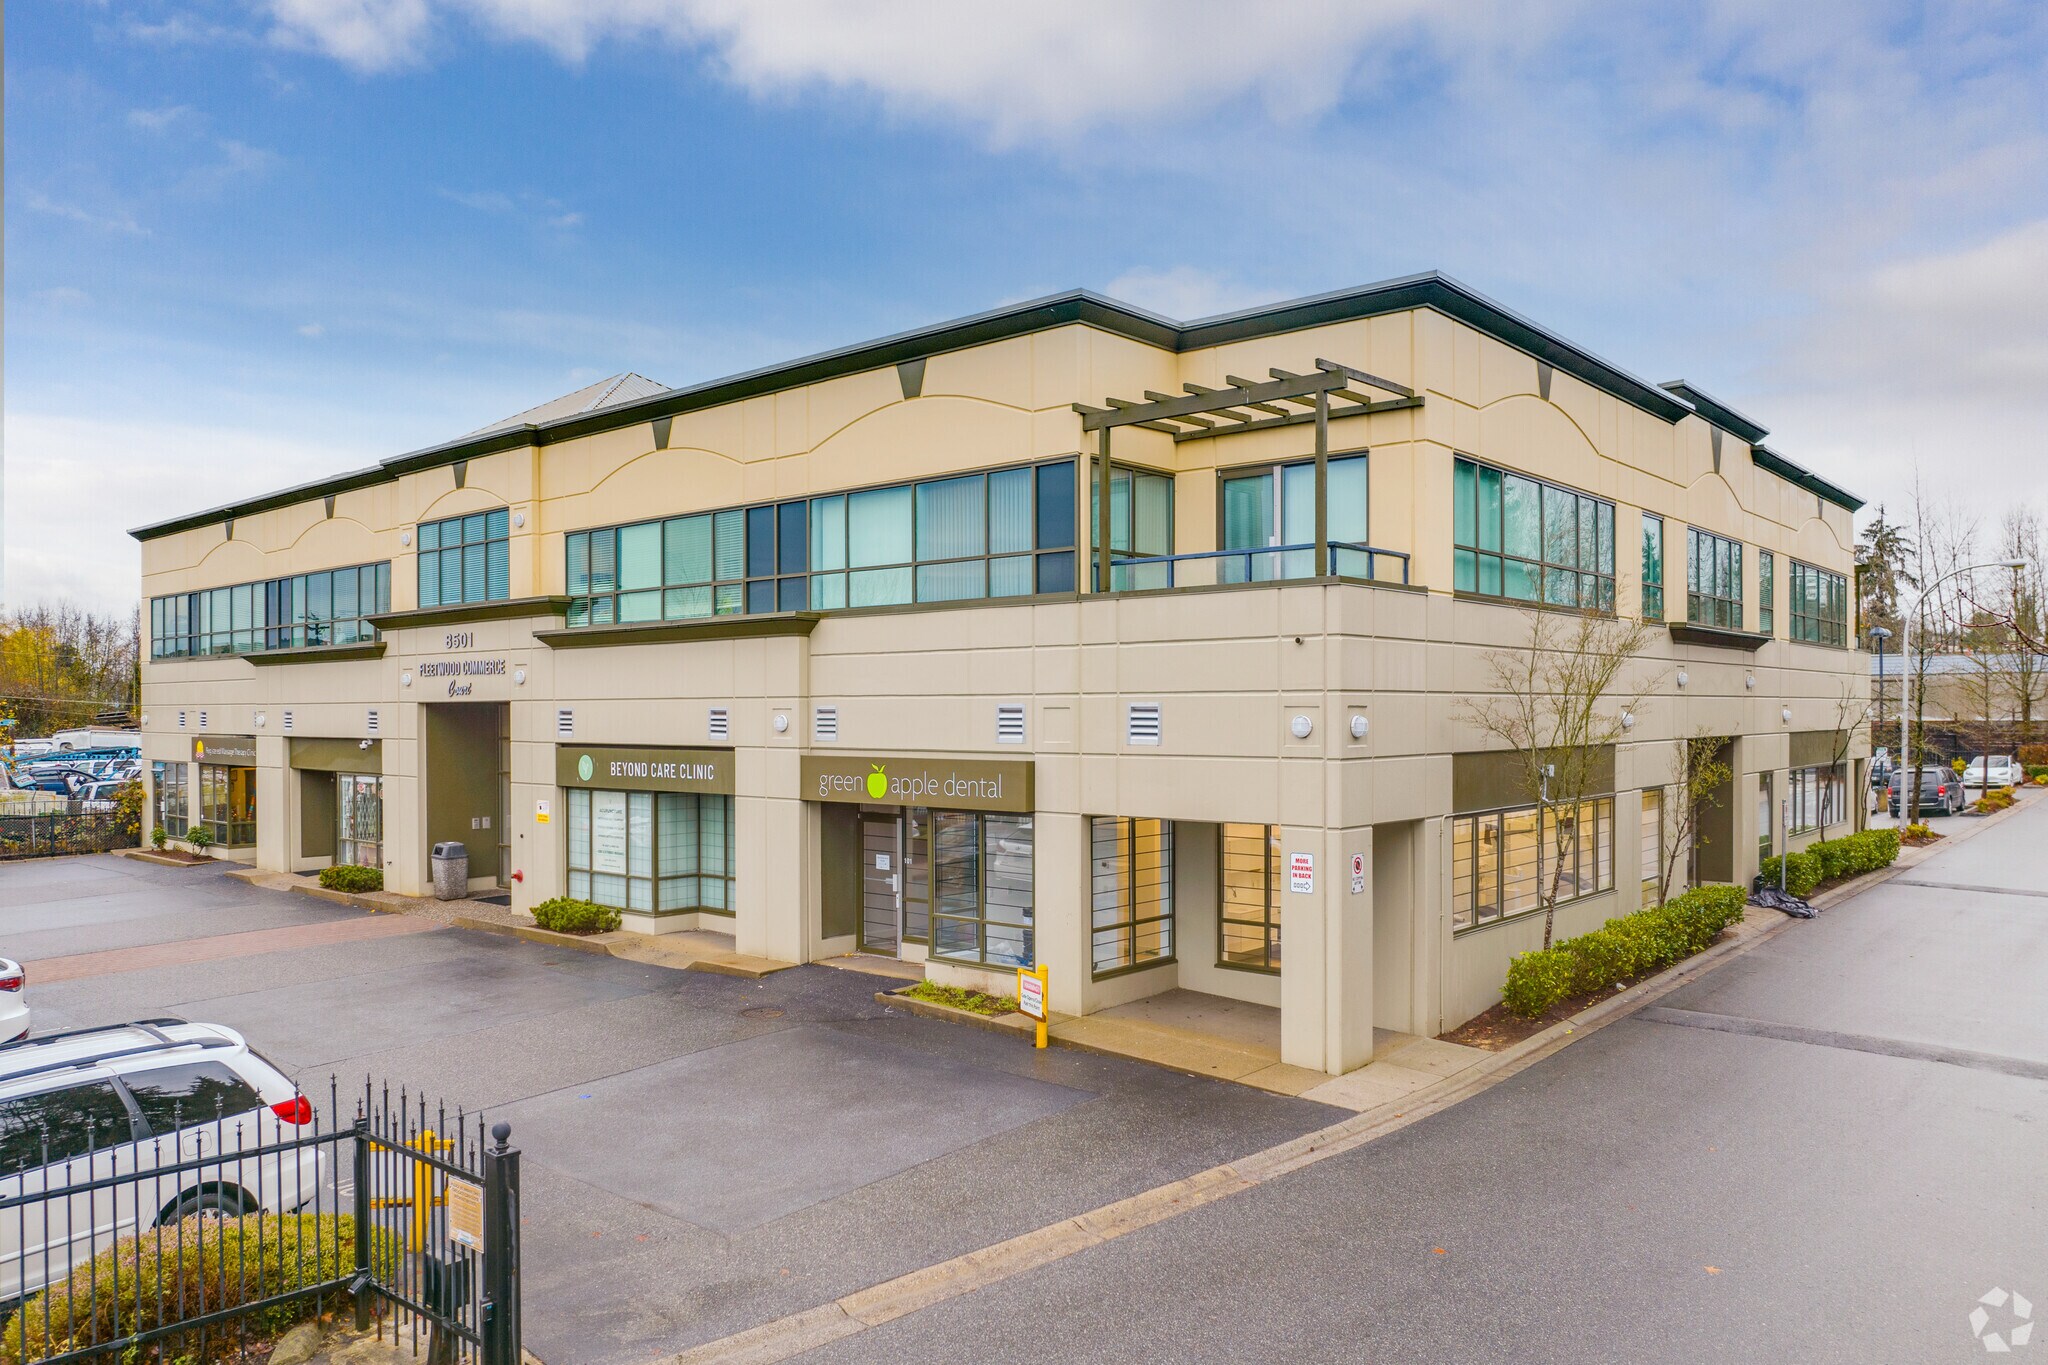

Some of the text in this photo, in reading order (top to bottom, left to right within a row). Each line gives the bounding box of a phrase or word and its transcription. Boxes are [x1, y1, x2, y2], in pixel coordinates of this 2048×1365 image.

[446, 632, 474, 649] 8501
[420, 659, 506, 677] FLEETWOOD COMMERCE
[610, 761, 714, 780] BEYOND CARE CLINIC
[818, 771, 1003, 801] green apple dental
